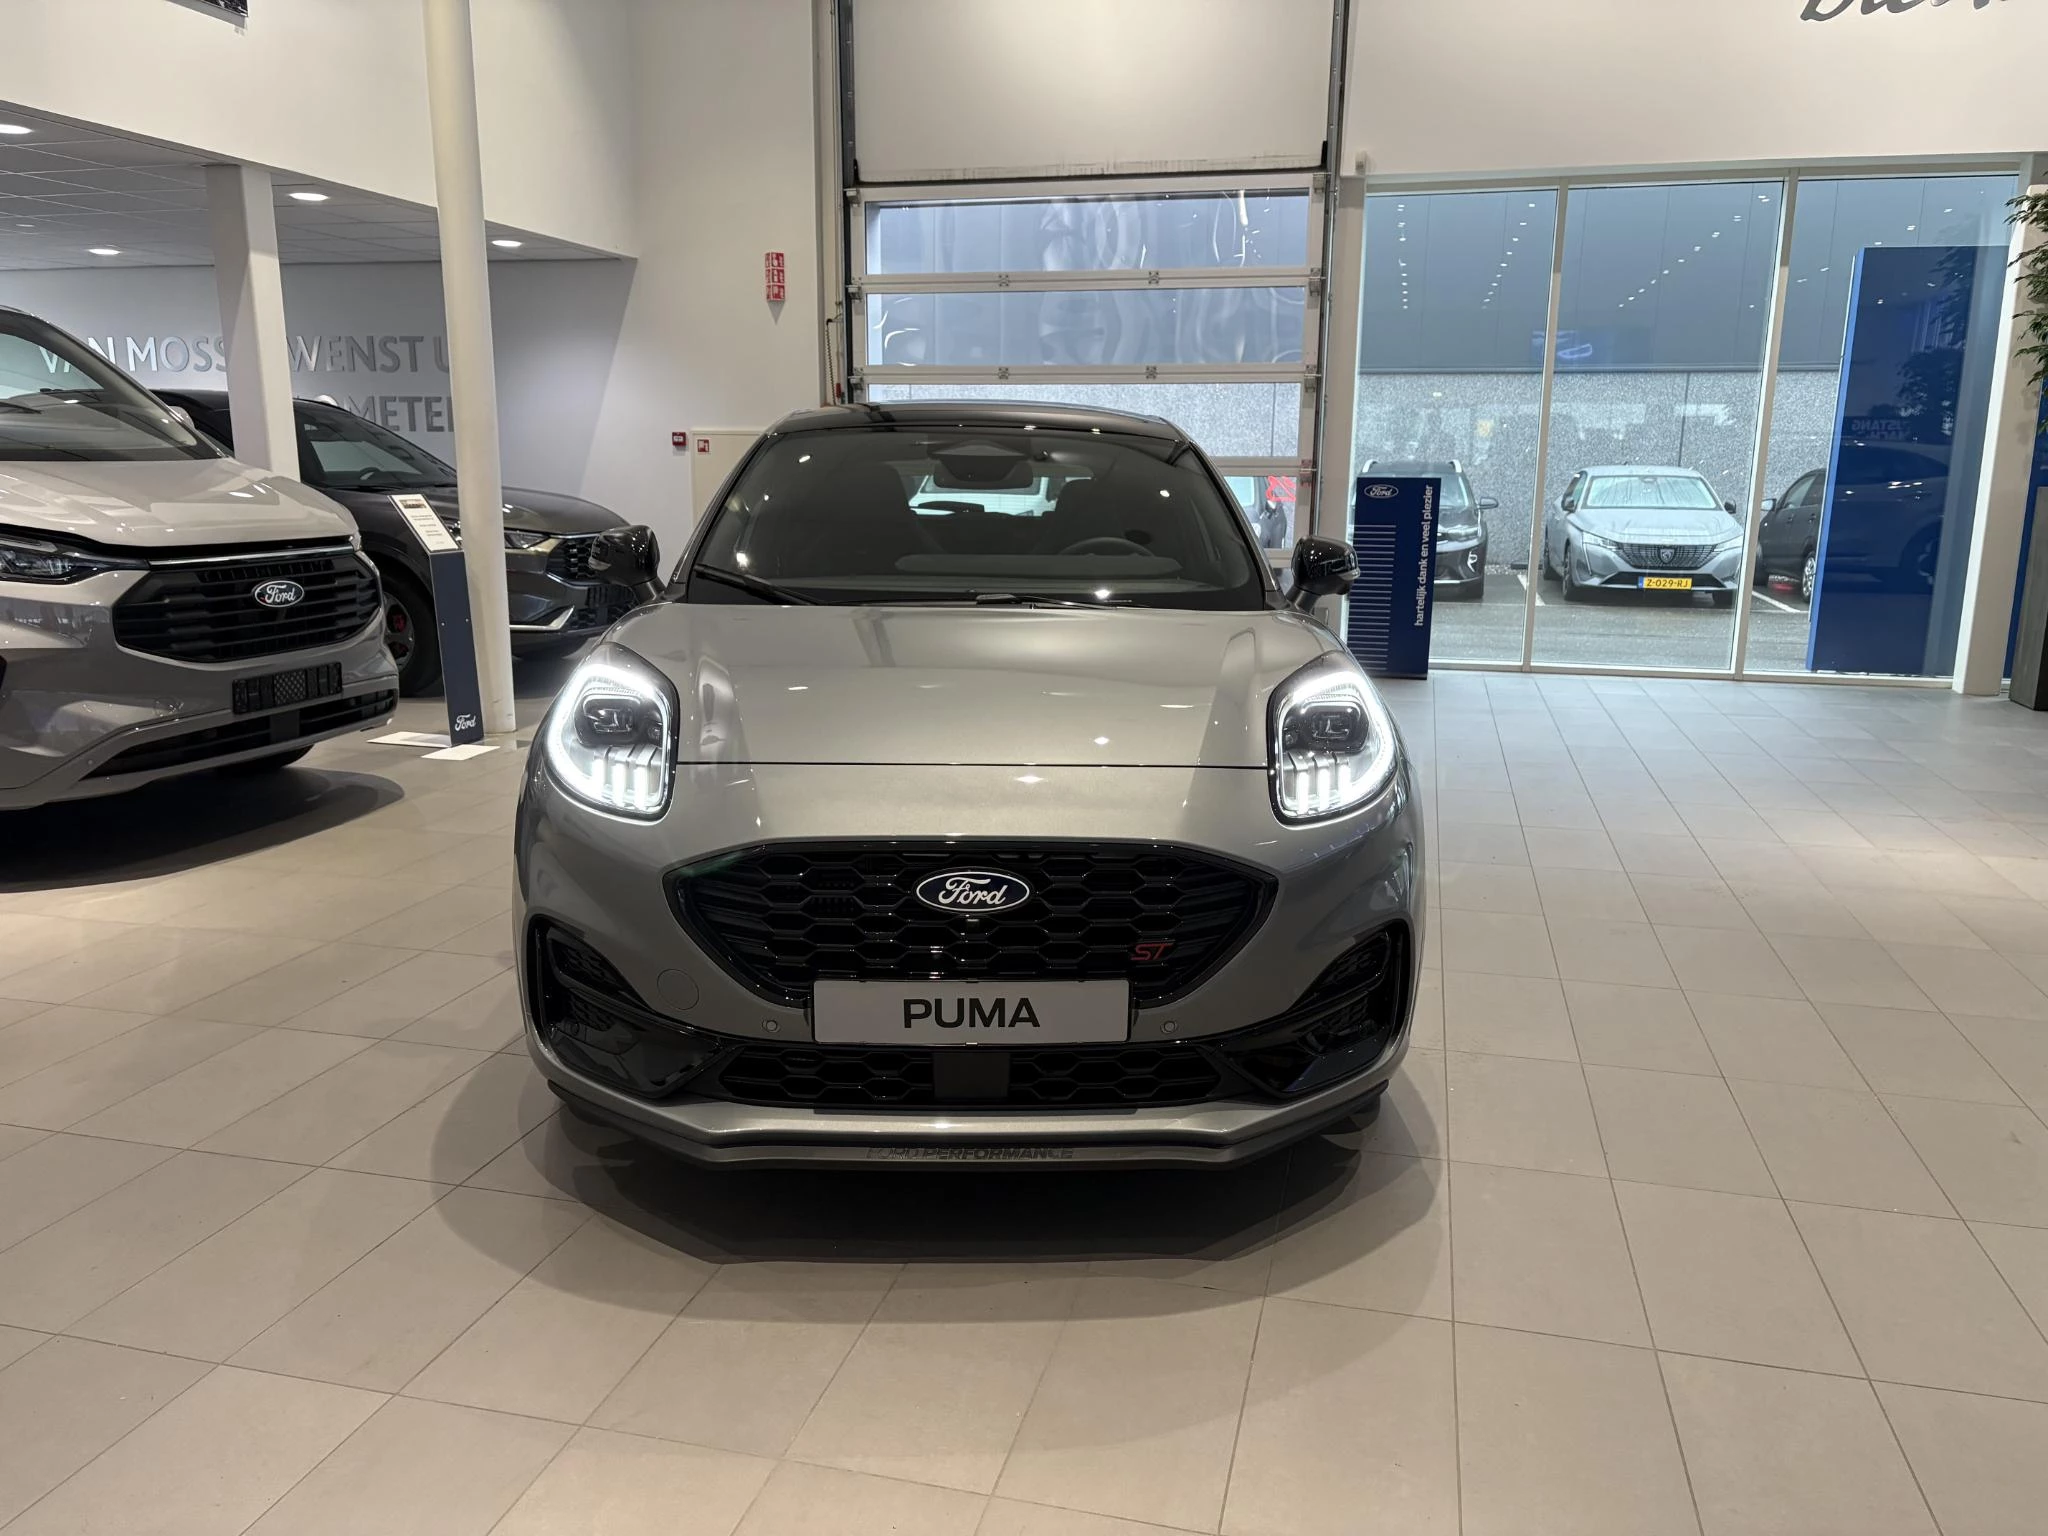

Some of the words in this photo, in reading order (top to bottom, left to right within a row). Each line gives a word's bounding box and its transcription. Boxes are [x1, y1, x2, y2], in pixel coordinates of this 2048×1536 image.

[38, 336, 116, 373] VN
[285, 335, 425, 374] WENST
[1369, 486, 1392, 496] Ford
[1422, 485, 1433, 520] plezier
[1421, 521, 1431, 543] veel
[1420, 543, 1429, 558] en
[1417, 558, 1428, 584] dank
[265, 584, 296, 603] Ford
[1414, 585, 1427, 627] hartelijk
[454, 713, 476, 731] Ford
[938, 876, 1008, 905] Ford
[1130, 942, 1176, 961] ST
[903, 997, 1040, 1029] PUMA
[921, 1147, 1074, 1161] PERFORMANCE
